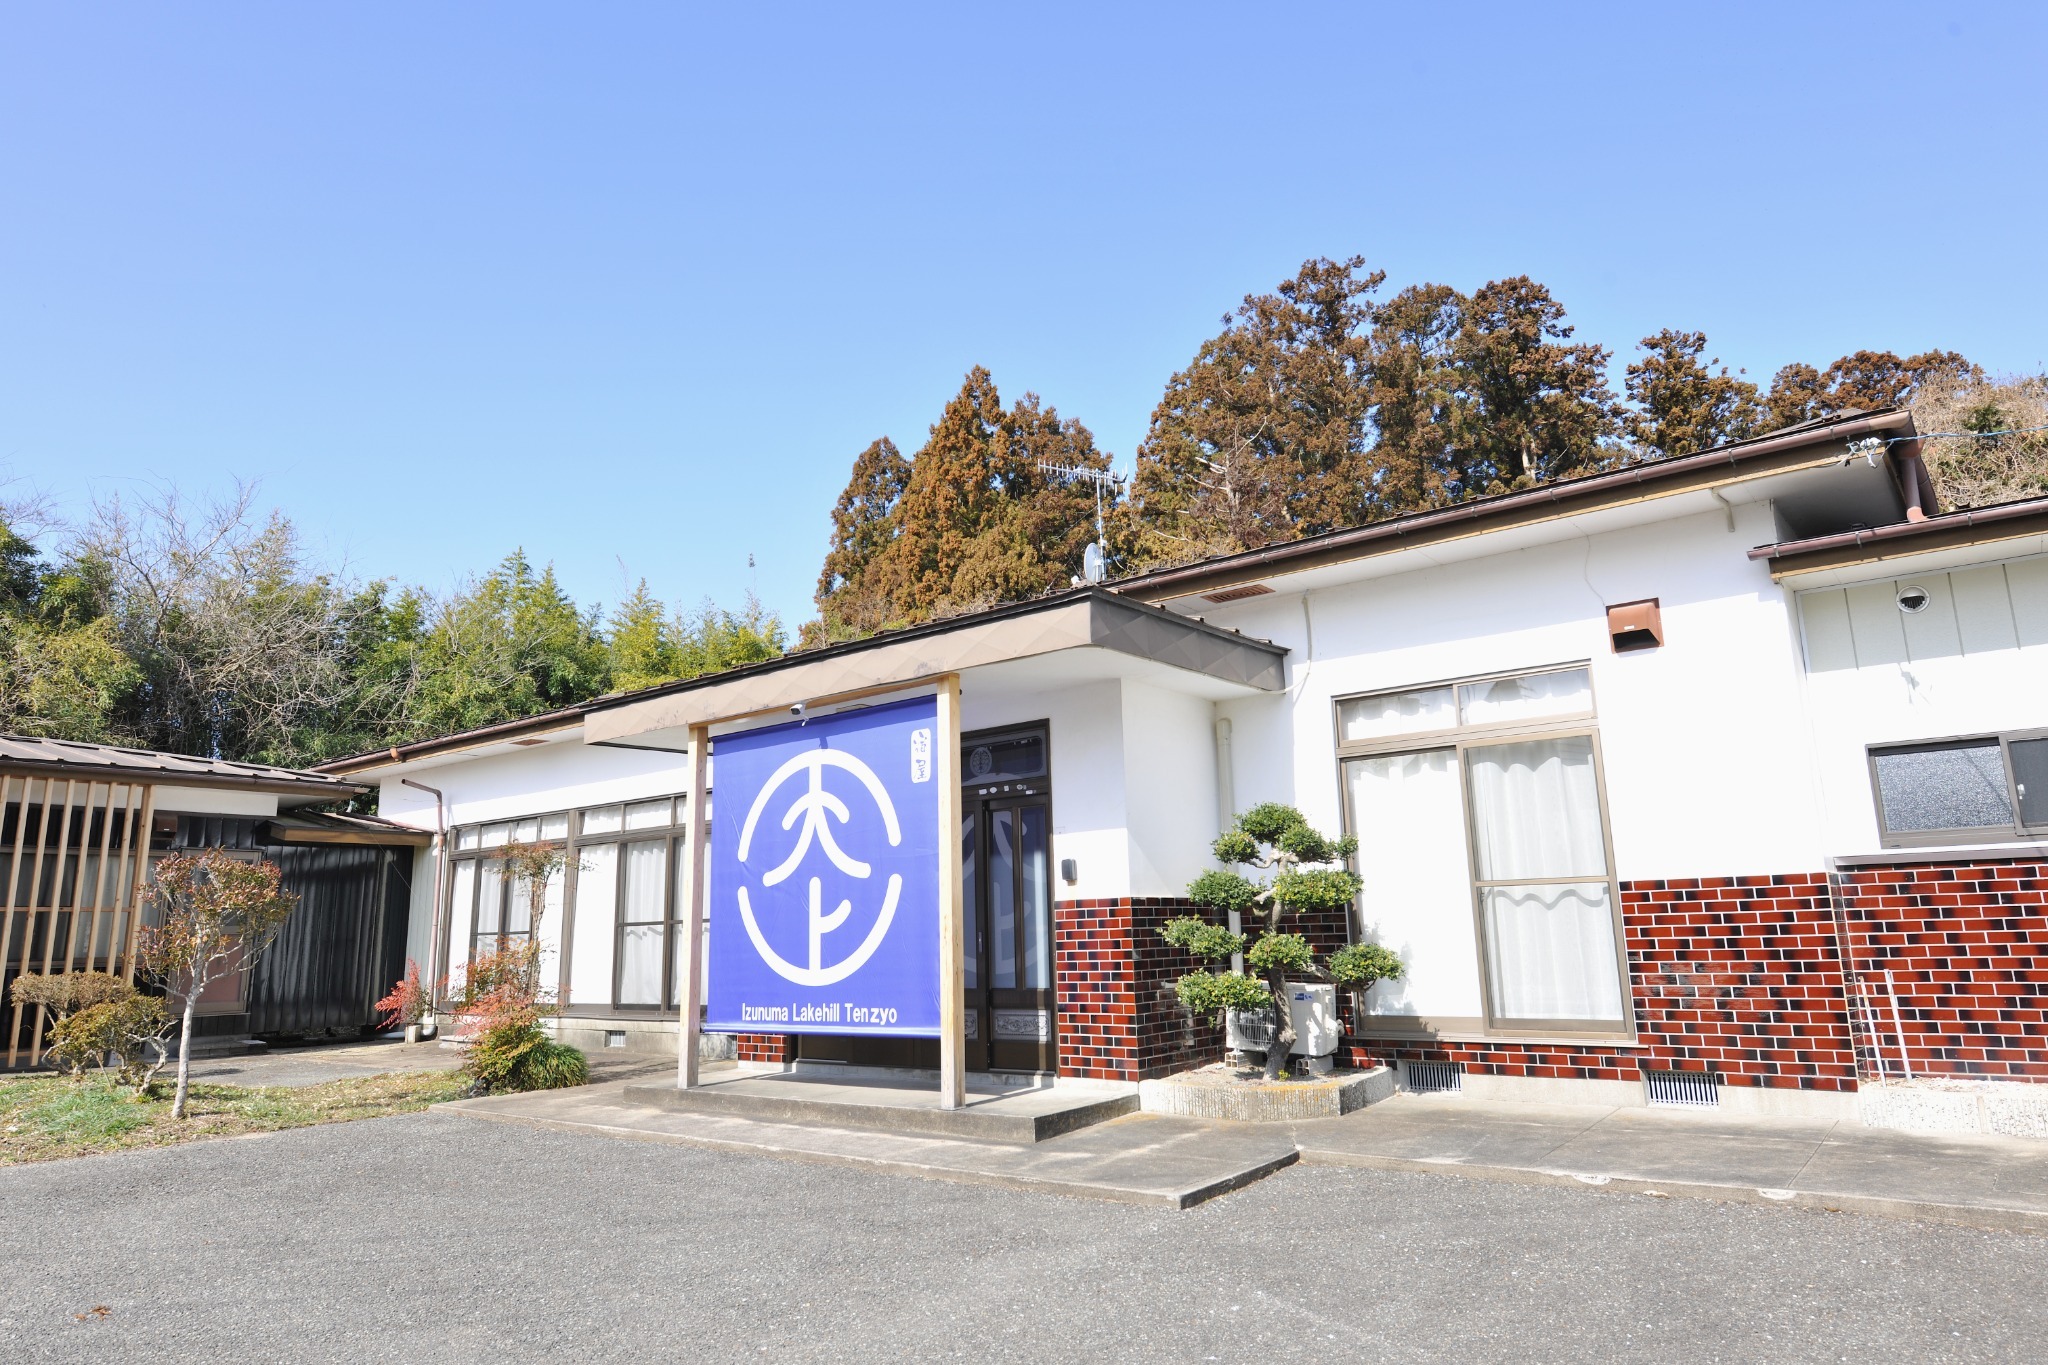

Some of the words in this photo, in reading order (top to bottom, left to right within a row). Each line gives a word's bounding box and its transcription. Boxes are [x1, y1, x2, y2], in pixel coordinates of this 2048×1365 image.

[742, 1002, 788, 1021] Izunuma
[792, 1002, 840, 1022] Lakehill
[844, 1002, 898, 1026] Tenzyo
